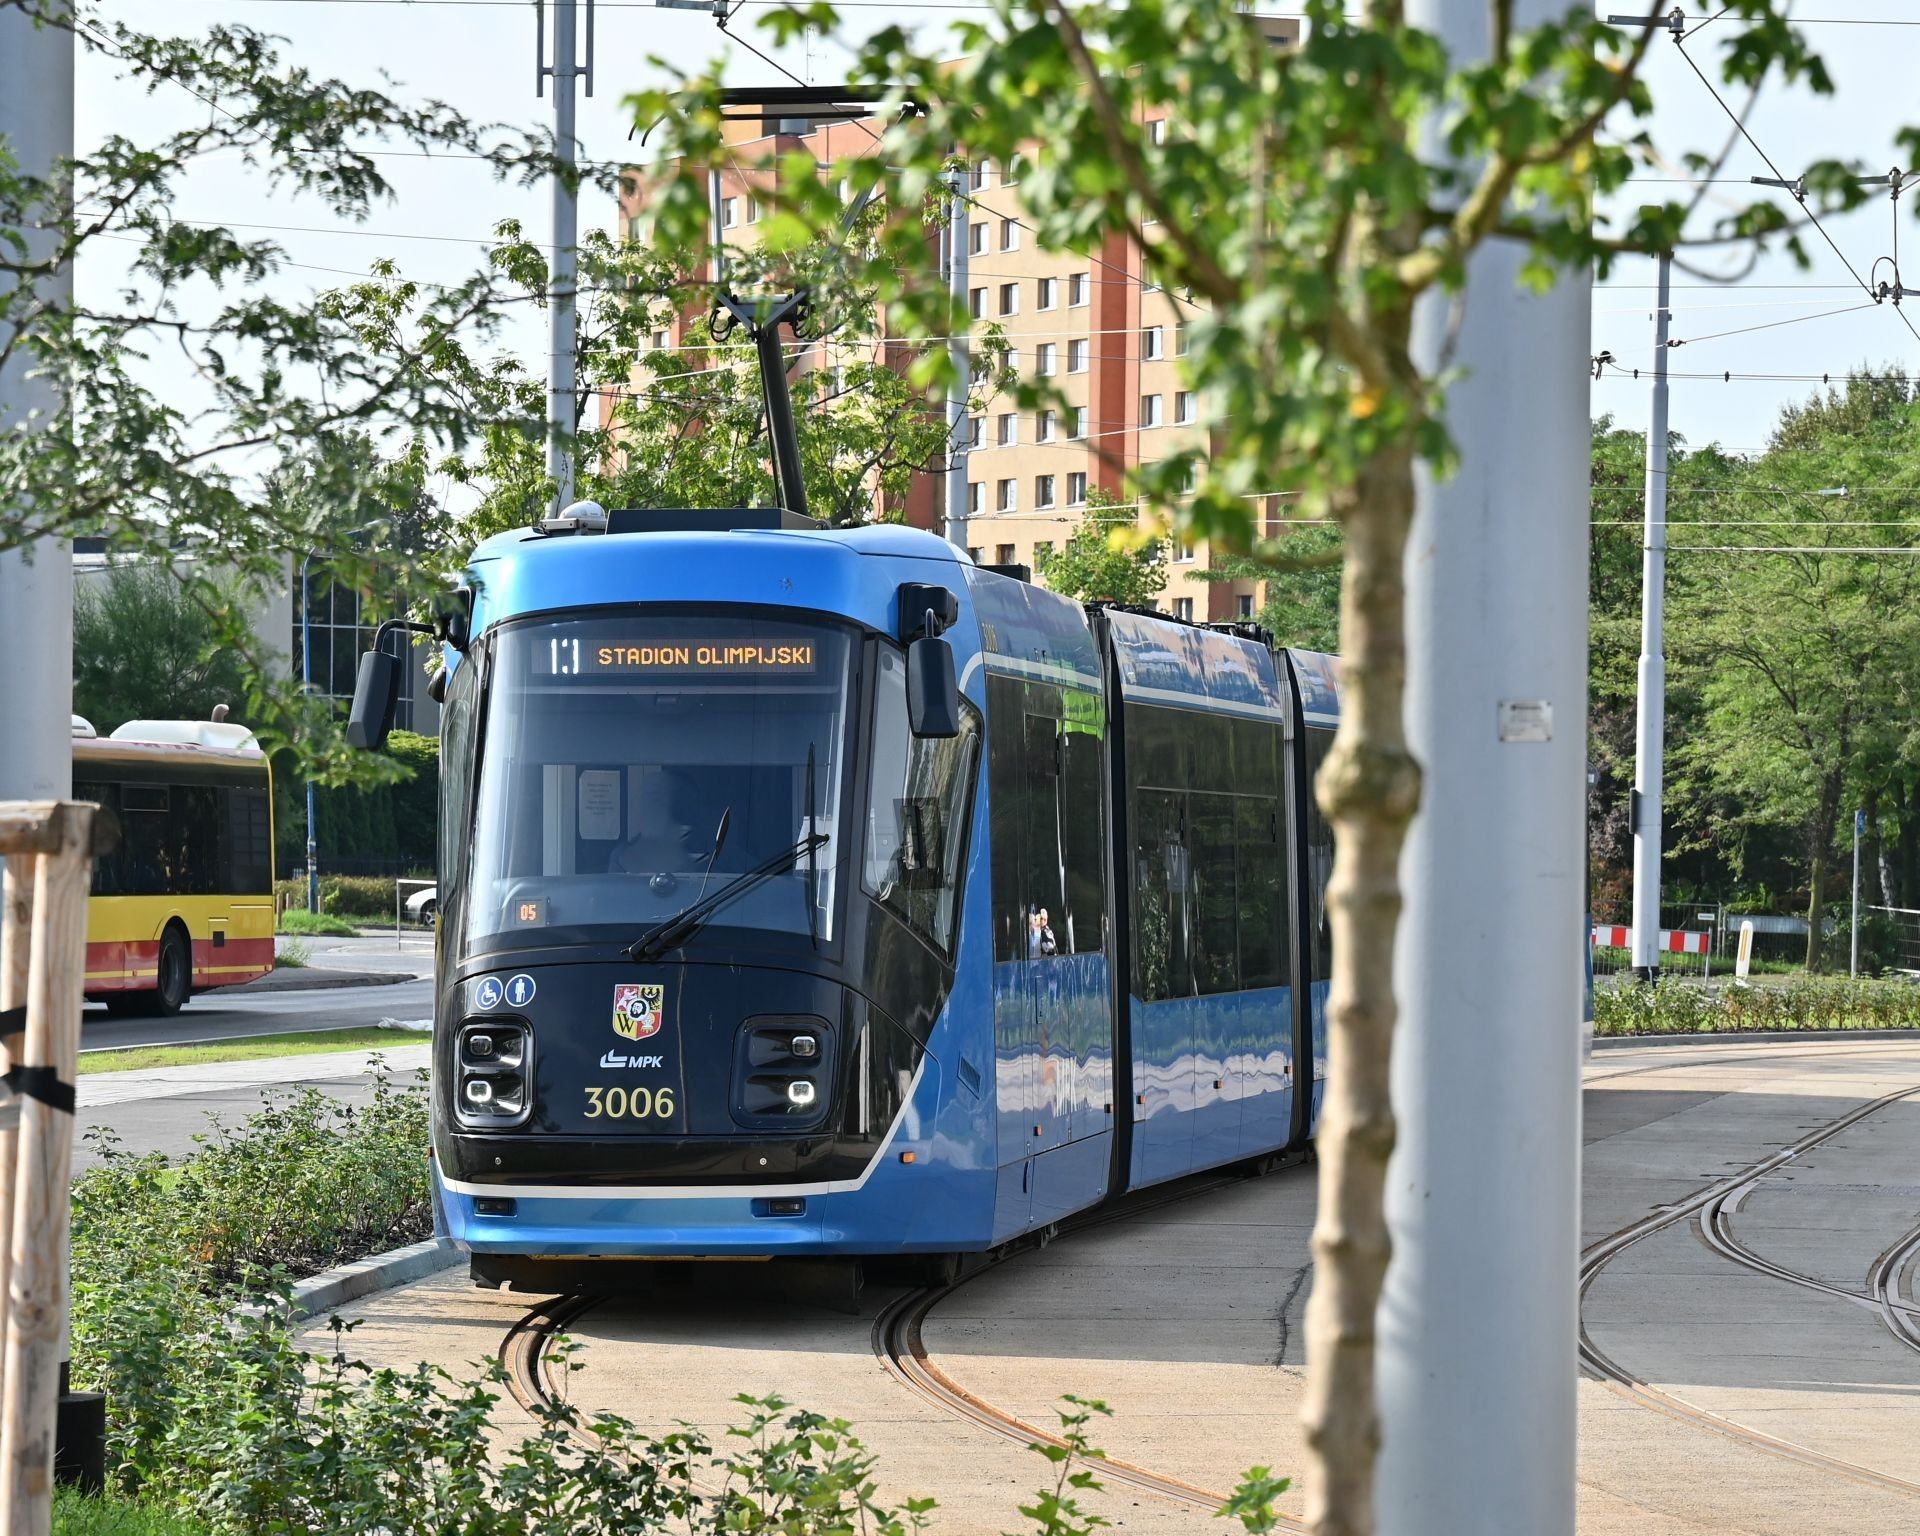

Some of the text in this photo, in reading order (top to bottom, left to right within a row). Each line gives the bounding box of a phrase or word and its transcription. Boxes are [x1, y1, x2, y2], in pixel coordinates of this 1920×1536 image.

[598, 648, 689, 665] STADION
[696, 647, 812, 664] OLIMPIJSKI
[520, 904, 537, 921] 05
[616, 1013, 635, 1033] W
[628, 1055, 663, 1068] MPK
[583, 1087, 675, 1119] 3006
